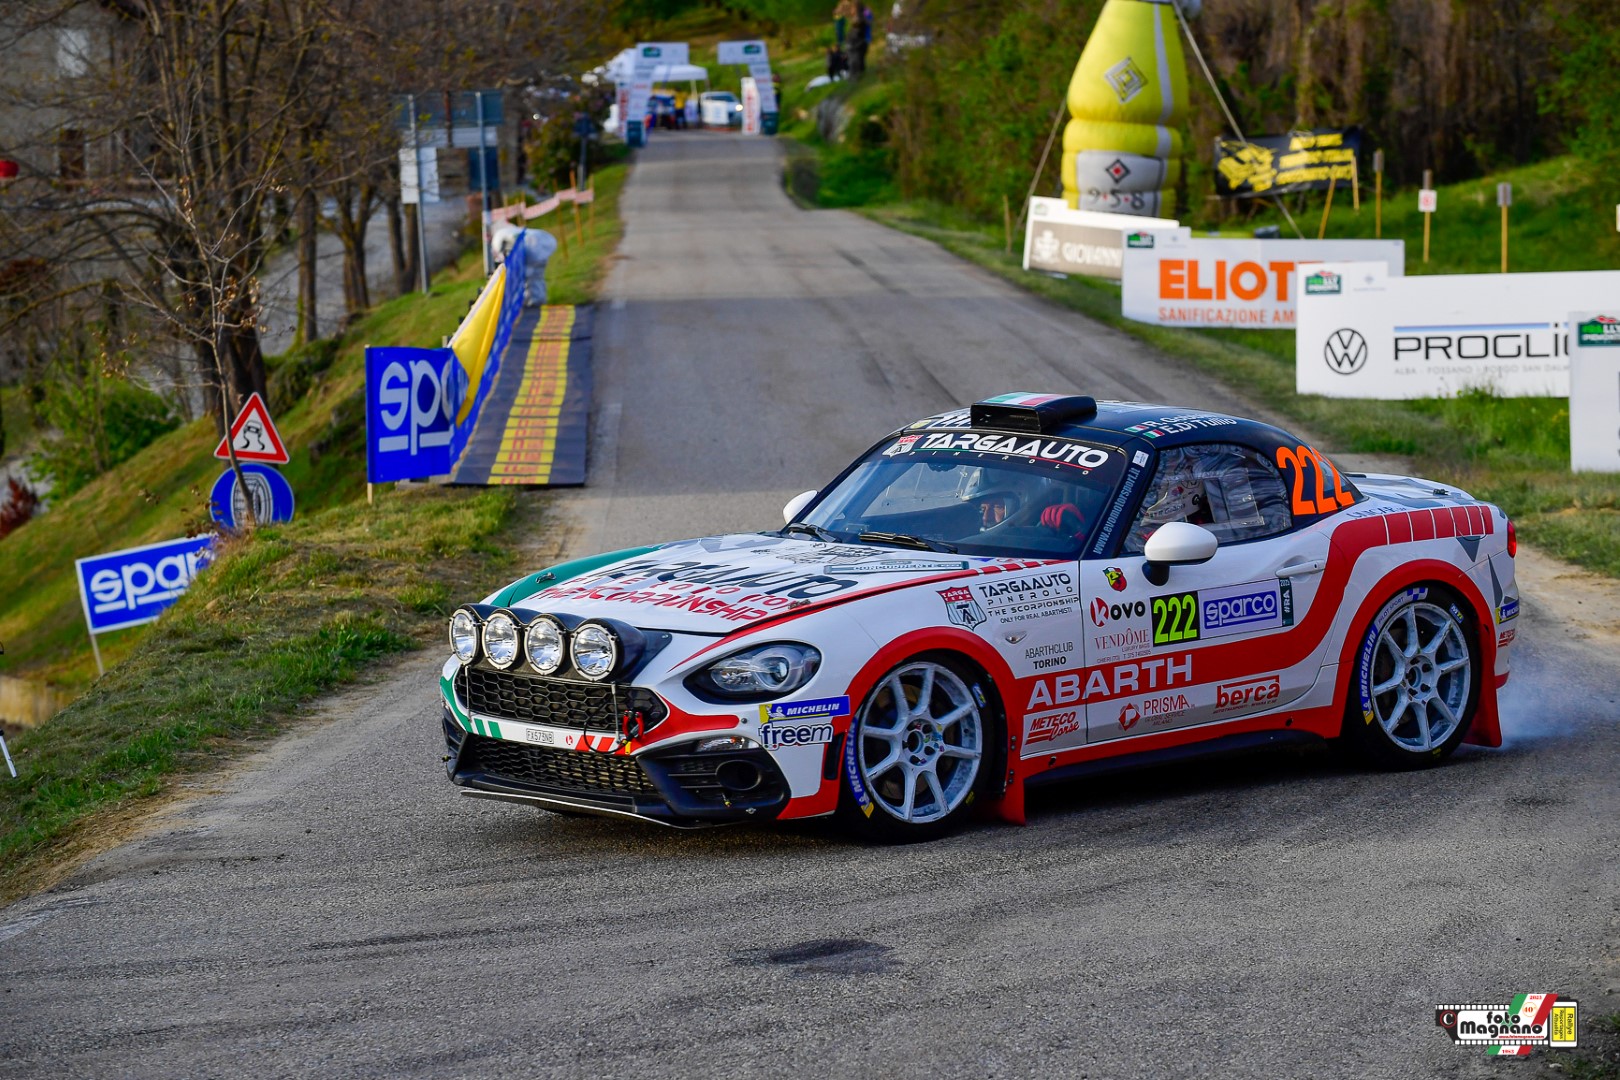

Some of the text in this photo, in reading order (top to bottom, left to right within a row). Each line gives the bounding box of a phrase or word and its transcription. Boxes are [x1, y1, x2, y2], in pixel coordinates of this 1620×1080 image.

[1158, 259, 1297, 302] ELIOT
[1158, 307, 1267, 323] SANIFICAZIONE
[1393, 322, 1568, 361] PROGLi
[1426, 365, 1473, 374] FOSSANO
[920, 433, 1109, 468] TARGAAUTO
[909, 450, 1089, 476] PINEROLO
[1275, 445, 1356, 516] 222
[1092, 467, 1141, 555] www.evomotorsport.it
[978, 573, 1071, 598] TARGAAUTO
[987, 586, 1073, 606] PINEROLO
[988, 596, 1080, 618] THE SCORPIONSHIP
[1000, 615, 1014, 624] ONLY
[1014, 613, 1026, 622] FOR
[1205, 594, 1275, 626] sparco
[1153, 594, 1198, 644] 222
[1025, 641, 1074, 660] ABARTHCLUB
[1094, 628, 1150, 650] VENDÔME
[1033, 656, 1067, 670] TORINO
[1361, 630, 1378, 698] MICHELIN
[1026, 654, 1193, 710] ABARTH
[1143, 694, 1191, 716] PRISMA
[1215, 682, 1280, 709] berca
[786, 703, 840, 716] MICHELIN
[1030, 711, 1077, 732] METECO
[760, 724, 833, 745] freem
